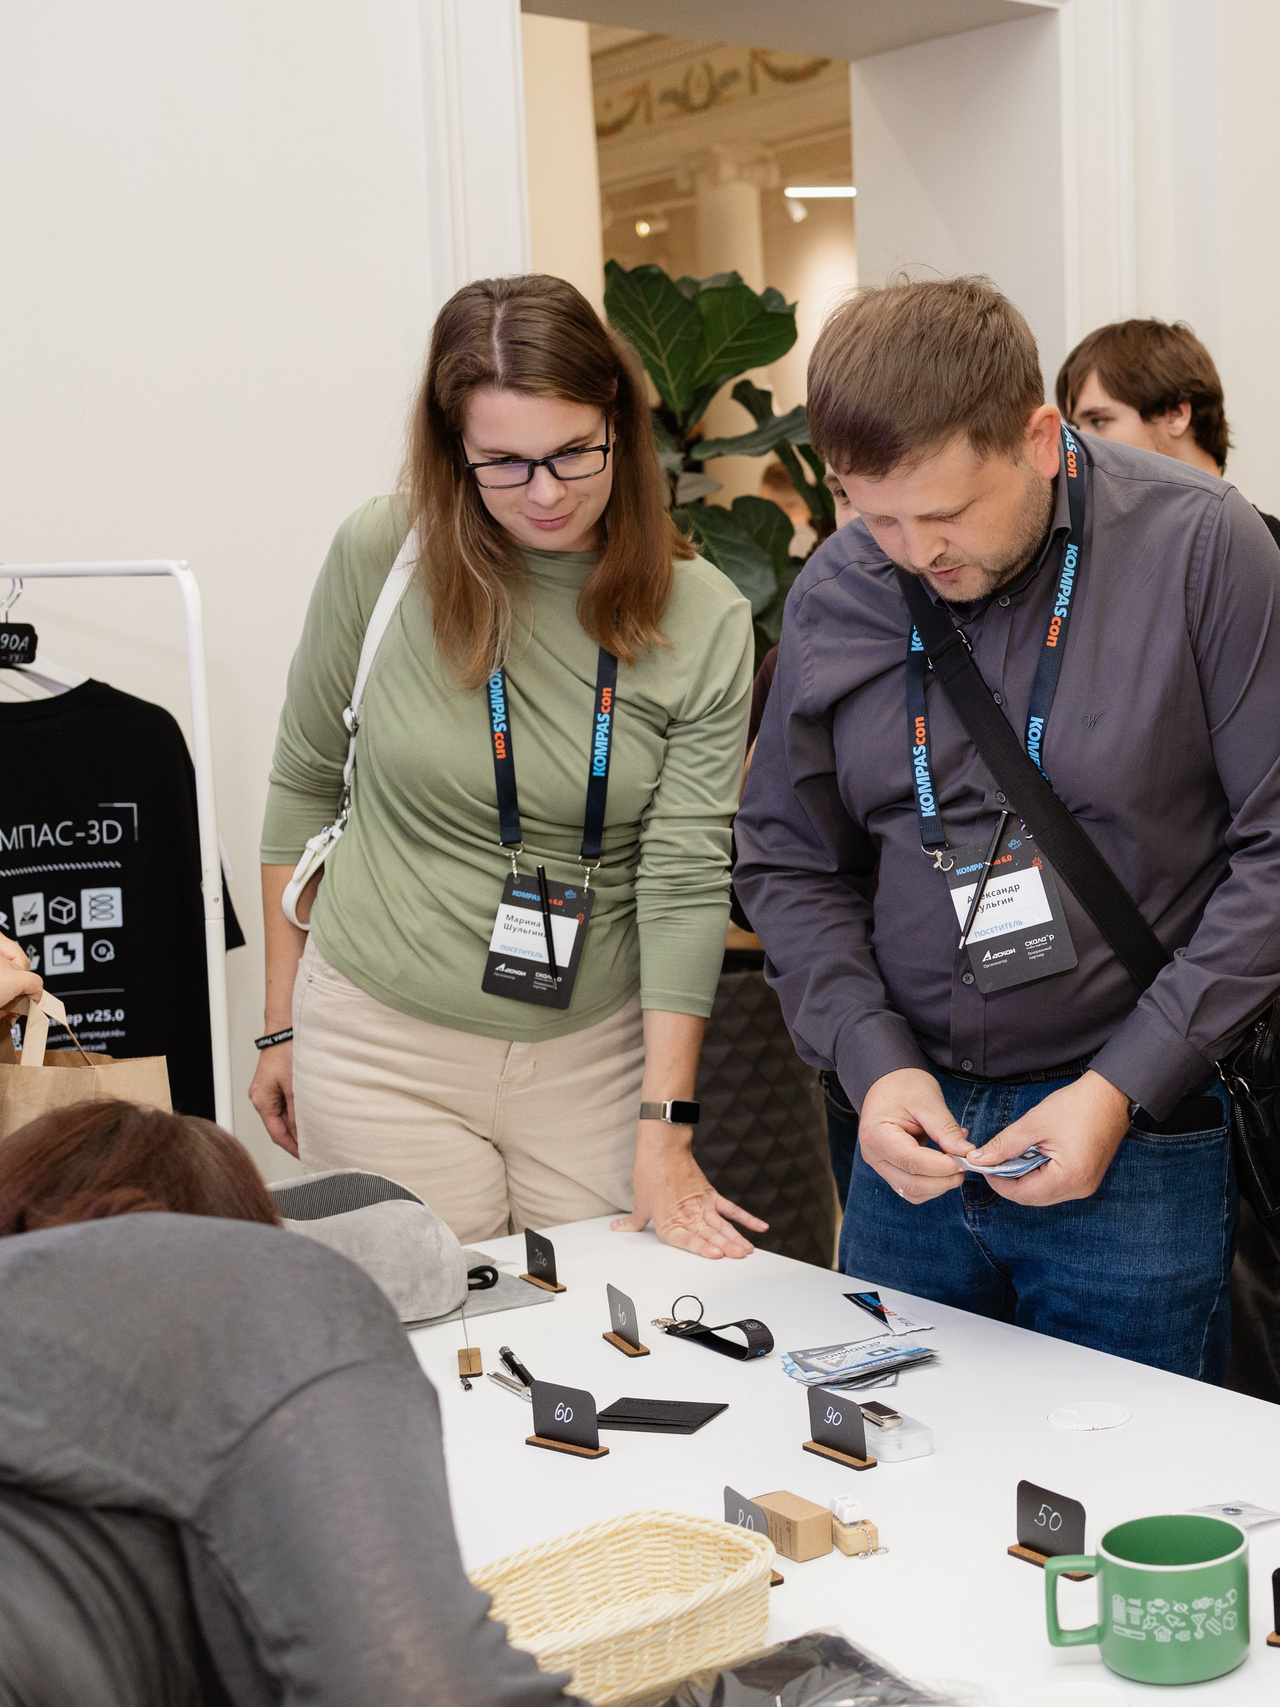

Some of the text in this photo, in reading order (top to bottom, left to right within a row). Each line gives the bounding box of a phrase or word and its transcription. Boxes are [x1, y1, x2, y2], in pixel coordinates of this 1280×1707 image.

[1046, 543, 1079, 648] KOMPAScon
[592, 686, 613, 777] KOMPAScon
[911, 716, 938, 818] KOMPAScon
[0, 819, 123, 852] МПАС-3D
[967, 884, 1020, 904] Аександр
[505, 914, 542, 928] Марина
[974, 920, 1024, 938] ПОСЕТИТЕЛЬ
[499, 943, 544, 960] ПОСЕТИТЕЛЬ
[85, 1008, 126, 1024] v25.0
[554, 1402, 574, 1424] 60
[823, 1405, 843, 1426] 90
[1033, 1503, 1063, 1532] 50
